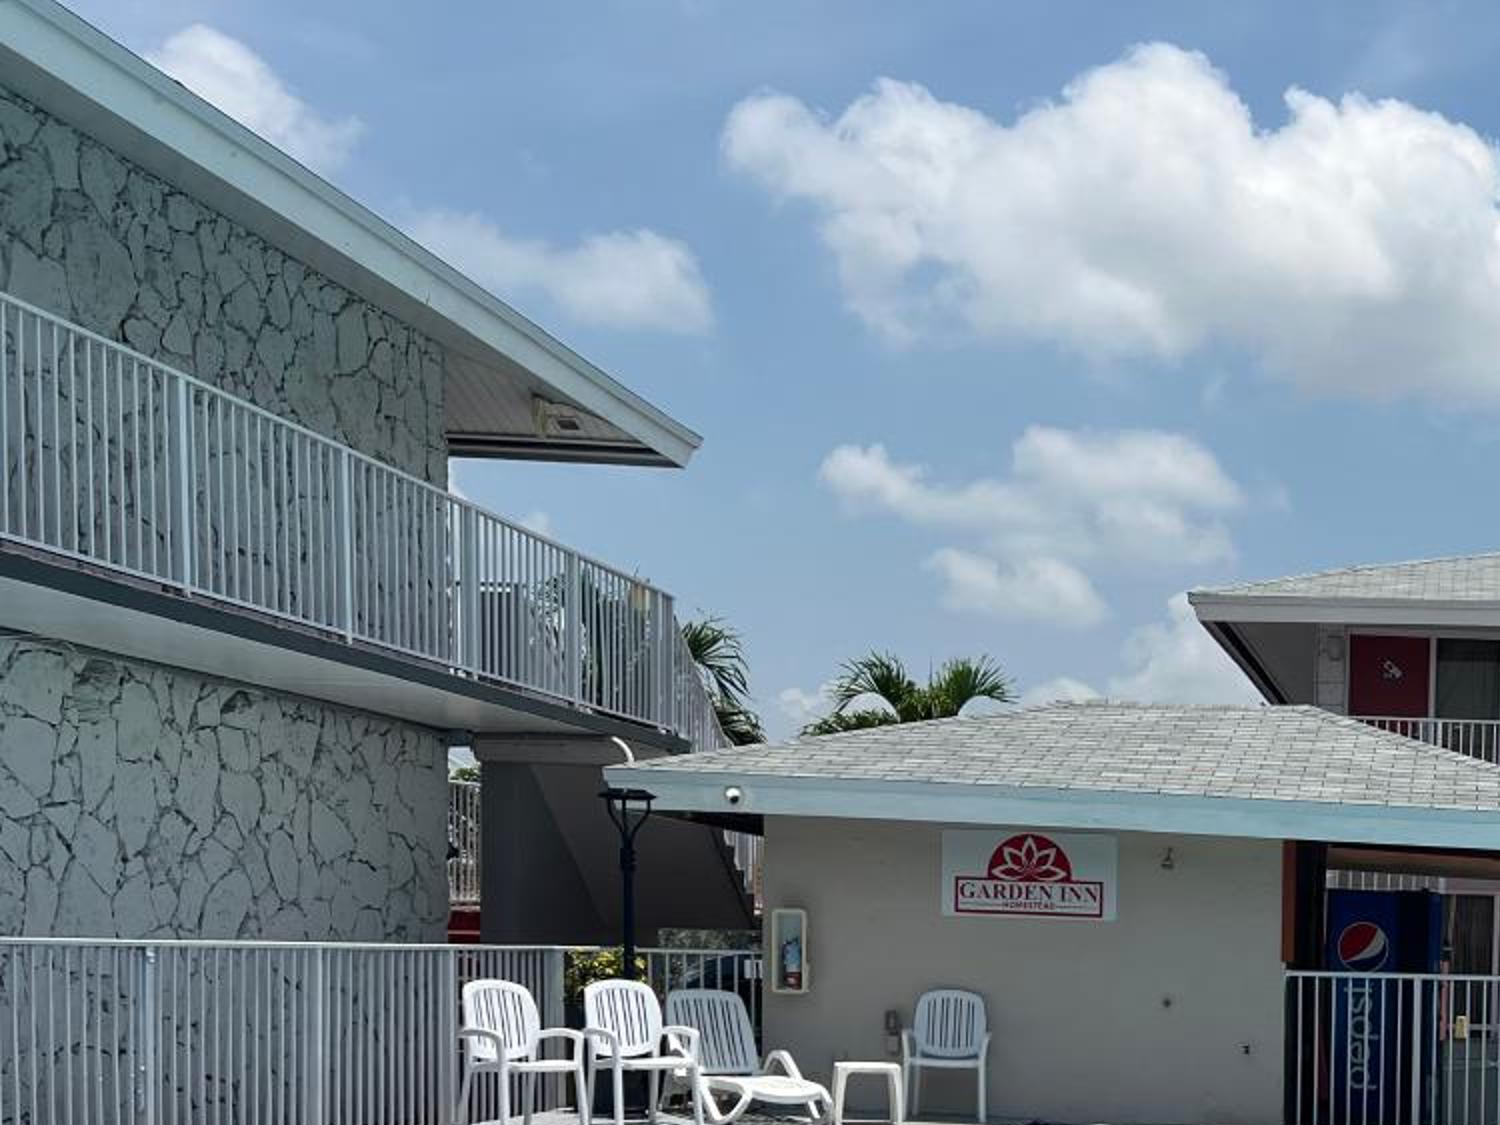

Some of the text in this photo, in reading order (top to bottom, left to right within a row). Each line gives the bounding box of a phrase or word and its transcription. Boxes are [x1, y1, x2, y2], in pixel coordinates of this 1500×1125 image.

[960, 881, 1098, 902] GARDEN INN
[1344, 987, 1379, 1090] pepsi
